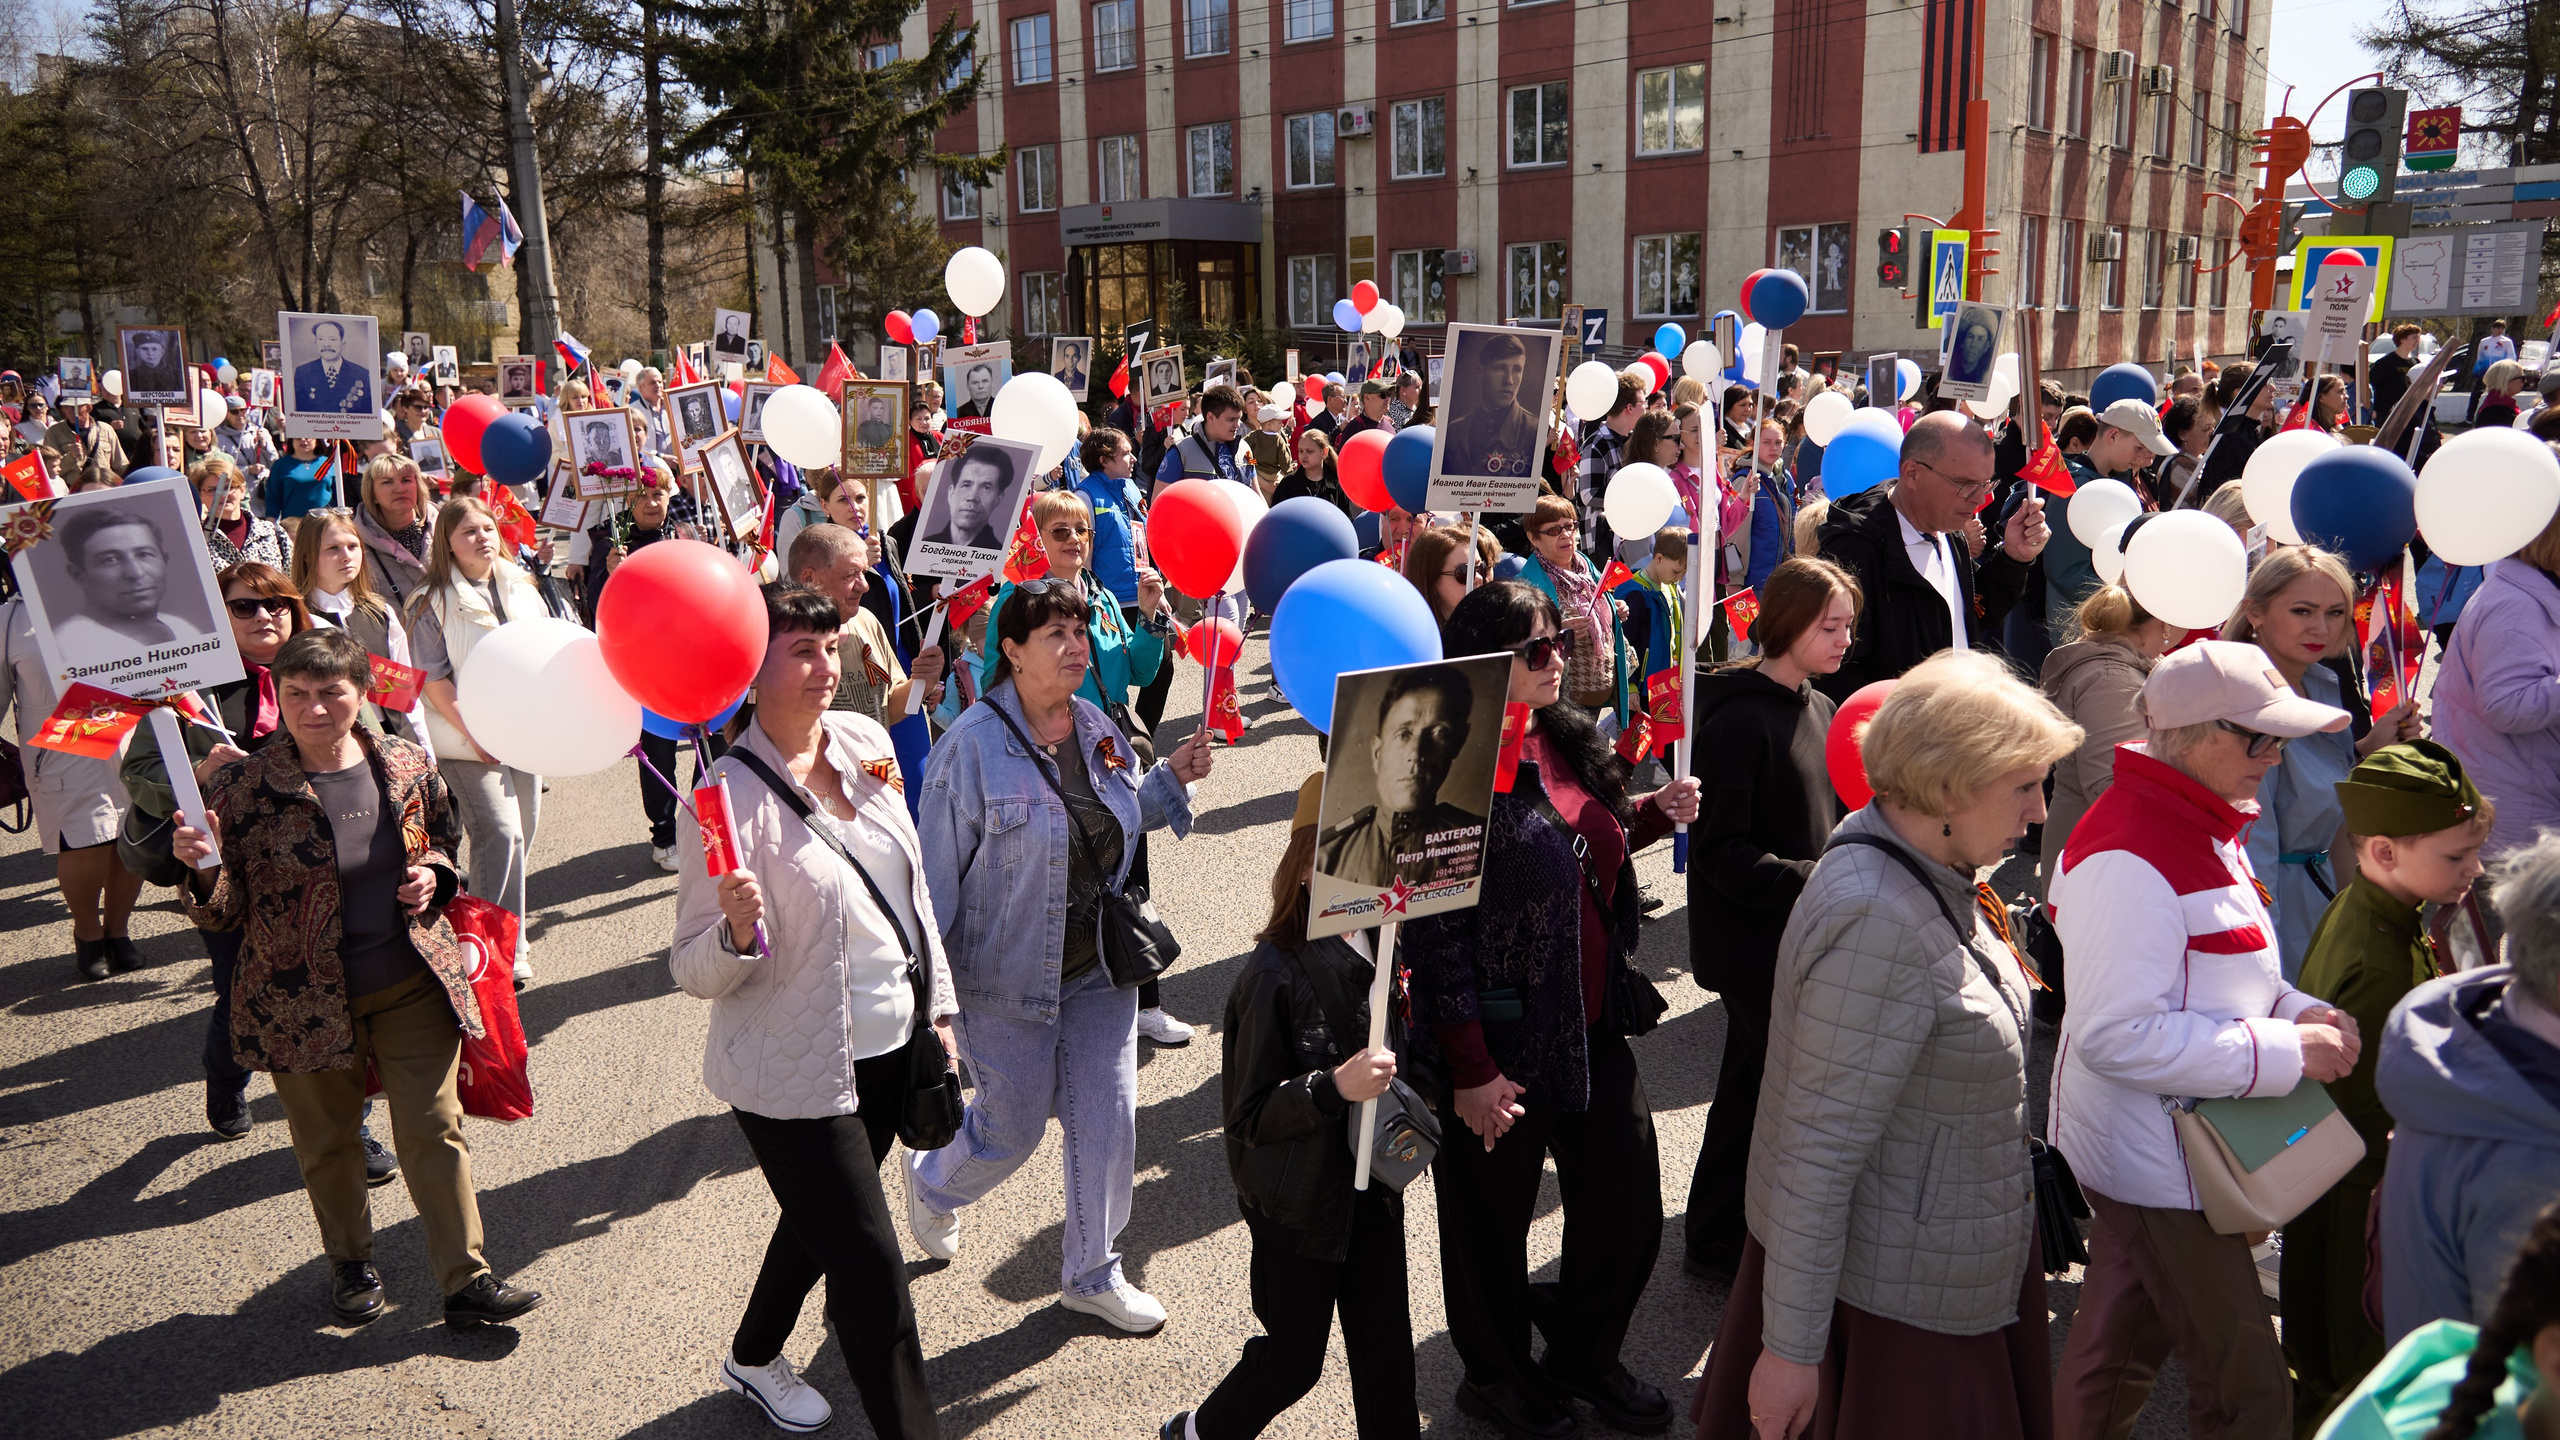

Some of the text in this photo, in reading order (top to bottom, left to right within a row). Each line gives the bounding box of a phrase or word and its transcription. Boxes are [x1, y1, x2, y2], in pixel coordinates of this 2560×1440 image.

[2395, 171, 2478, 189] ЦИАЛЬНЫЙ
[2413, 210, 2451, 222] РОДА
[1066, 221, 1160, 235] АДМИНИСТРАЦИЯ ЛЕНИНСК-КУЗНЕЦКОГО
[1084, 230, 1134, 240] ГОРОДСКОГО ОКРУГА
[1884, 264, 1901, 280] 54
[1585, 317, 1605, 346] Z
[1130, 331, 1149, 368] Z
[953, 417, 991, 428] СОБЯНИ
[1432, 478, 1537, 489] Иванов Иван Евгеньевич
[920, 544, 998, 562] Богданов Тихон
[941, 556, 973, 566] сержант
[67, 638, 221, 679] Занилов Николай
[110, 661, 188, 685] лейтенант
[1425, 825, 1482, 845] ВАХТЕРОВ
[1396, 841, 1480, 865] Петр Иванович
[1448, 853, 1479, 865] сержант
[1435, 863, 1477, 878] 1914-1998г.
[1428, 878, 1455, 890] нами
[1411, 882, 1468, 903] на всегда!
